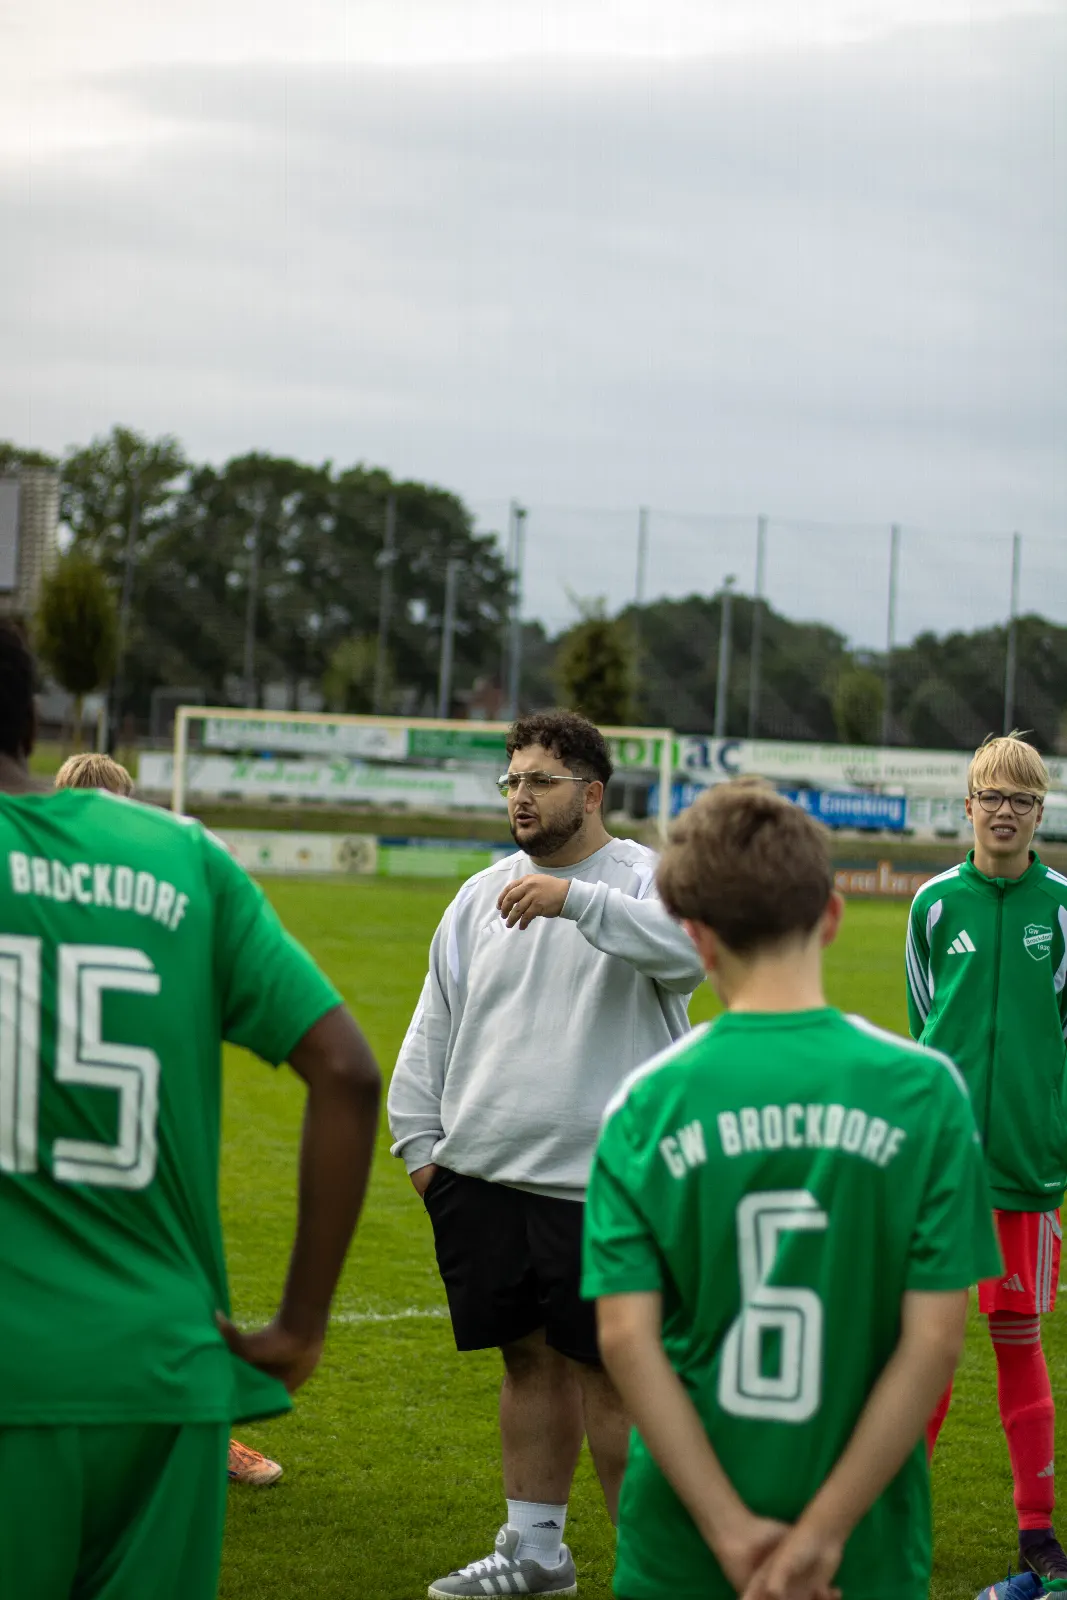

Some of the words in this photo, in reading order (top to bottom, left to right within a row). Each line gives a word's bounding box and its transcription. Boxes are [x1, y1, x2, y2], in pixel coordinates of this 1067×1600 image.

[615, 737, 741, 773] onac
[9, 851, 190, 931] BROCKDORF
[0, 934, 160, 1190] 15
[659, 1120, 707, 1179] GW
[717, 1103, 906, 1166] BROCKDORF
[717, 1189, 828, 1423] 6
